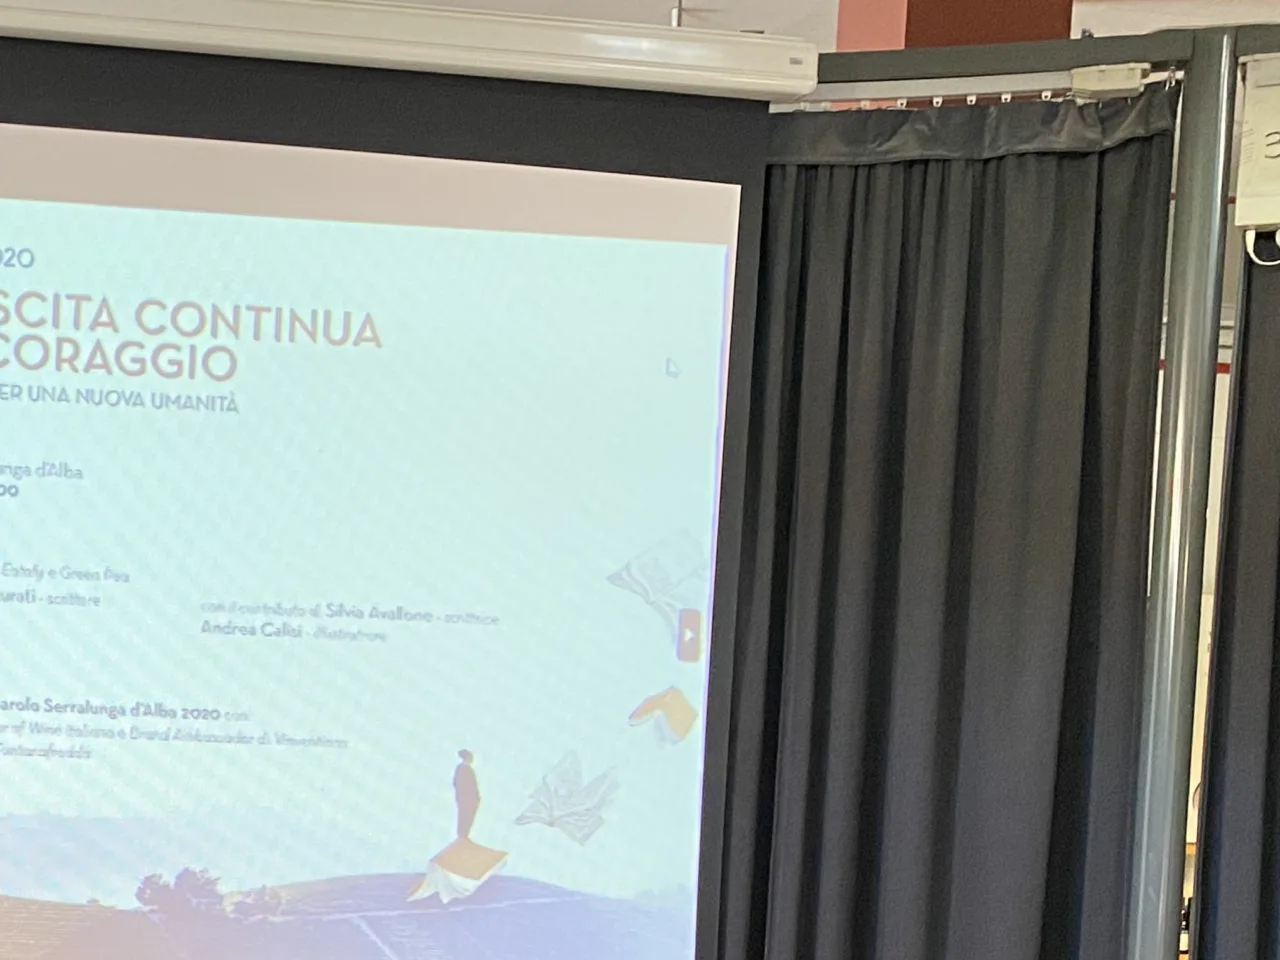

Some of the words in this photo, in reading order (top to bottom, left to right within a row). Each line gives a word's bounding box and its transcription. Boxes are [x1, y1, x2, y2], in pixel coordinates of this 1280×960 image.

[135, 298, 383, 349] CONTINUA
[28, 384, 71, 404] UNA
[75, 387, 146, 409] NUOVA
[150, 389, 239, 413] UMANITÀ
[325, 603, 365, 620] Silvia
[368, 605, 434, 623] Avallone
[200, 620, 257, 637] Andrea
[260, 622, 303, 639] Calisi
[43, 698, 126, 720] Serralunga
[130, 701, 177, 719] d'Alba
[181, 707, 221, 721] 2020
